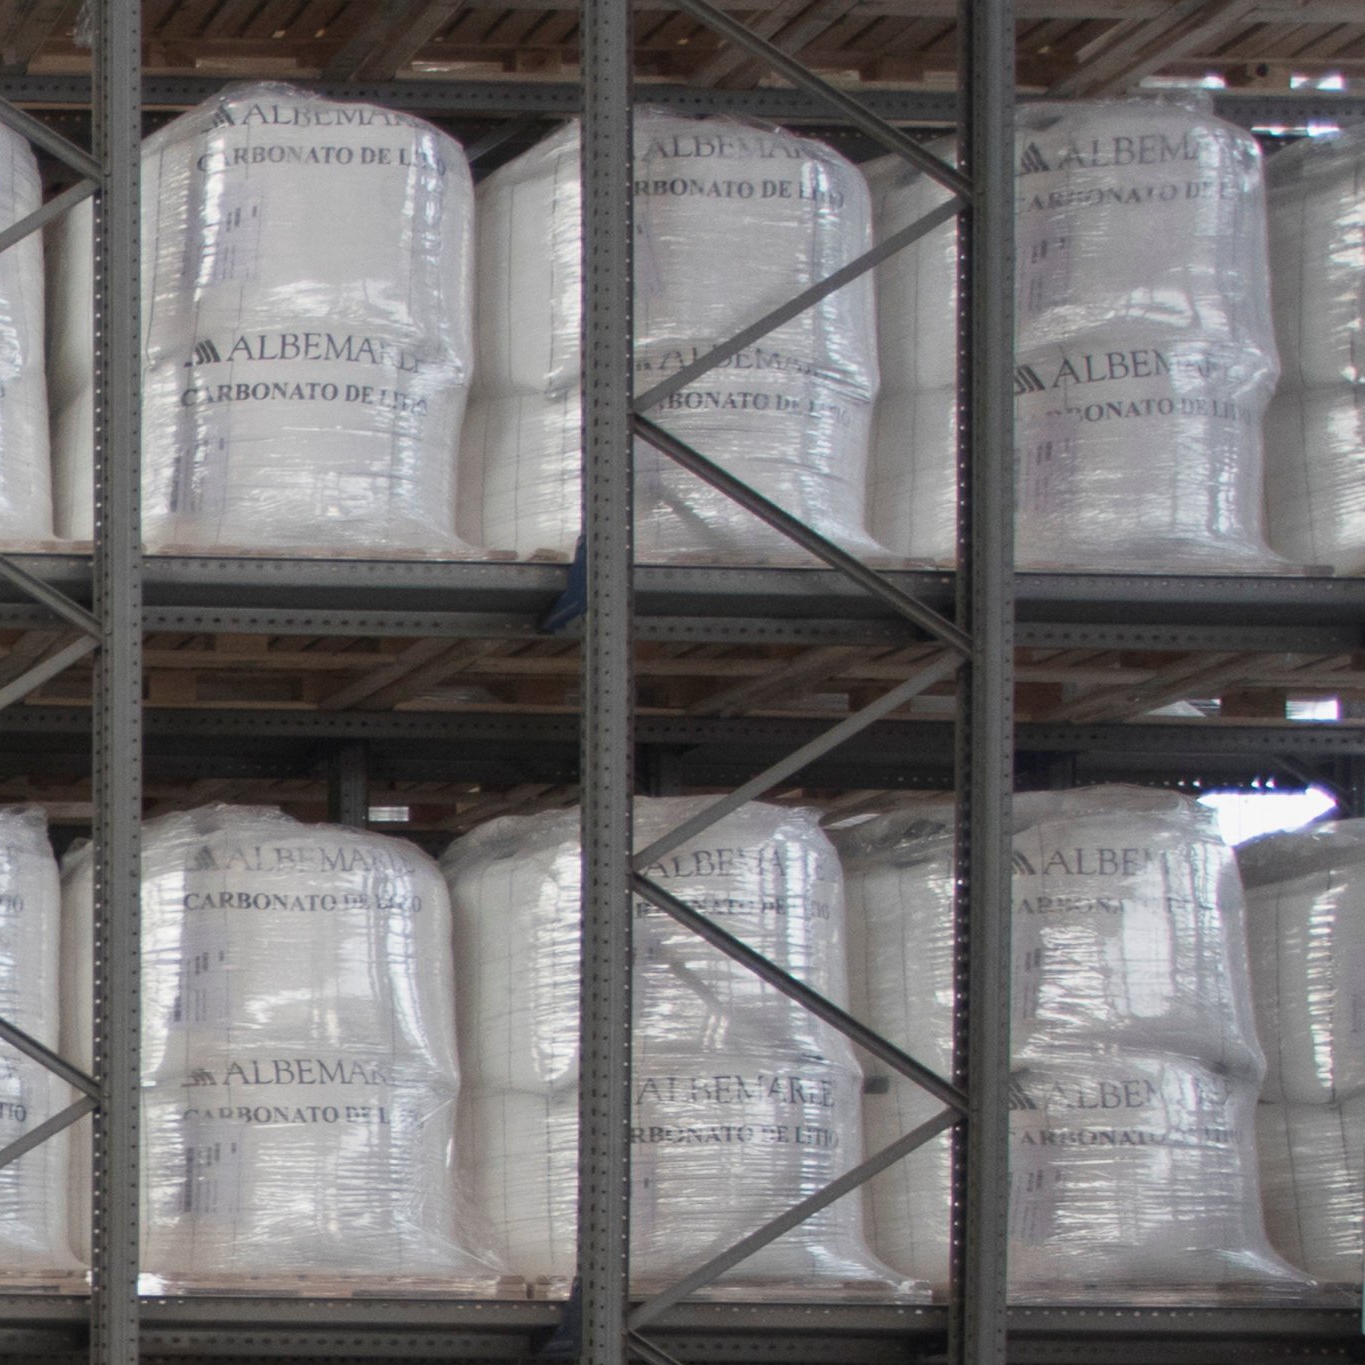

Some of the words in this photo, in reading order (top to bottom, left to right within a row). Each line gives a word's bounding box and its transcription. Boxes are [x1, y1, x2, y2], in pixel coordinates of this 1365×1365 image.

[245, 102, 418, 129] ALBEMA
[196, 146, 354, 173] CRBONATO
[361, 147, 392, 165] DE
[1057, 133, 1199, 170] ALBEM
[633, 179, 755, 200] RBONATO
[761, 179, 793, 200] DE
[226, 332, 421, 374] ALBEMAL
[344, 384, 374, 404] DE
[657, 390, 769, 412] BONATO
[225, 845, 417, 875] ALBEMA
[183, 891, 338, 912] CARBONATO
[221, 1059, 397, 1086] ALBEMAR
[632, 1126, 754, 1145] RBONATO
[1013, 1129, 1168, 1147] ARBONATO
